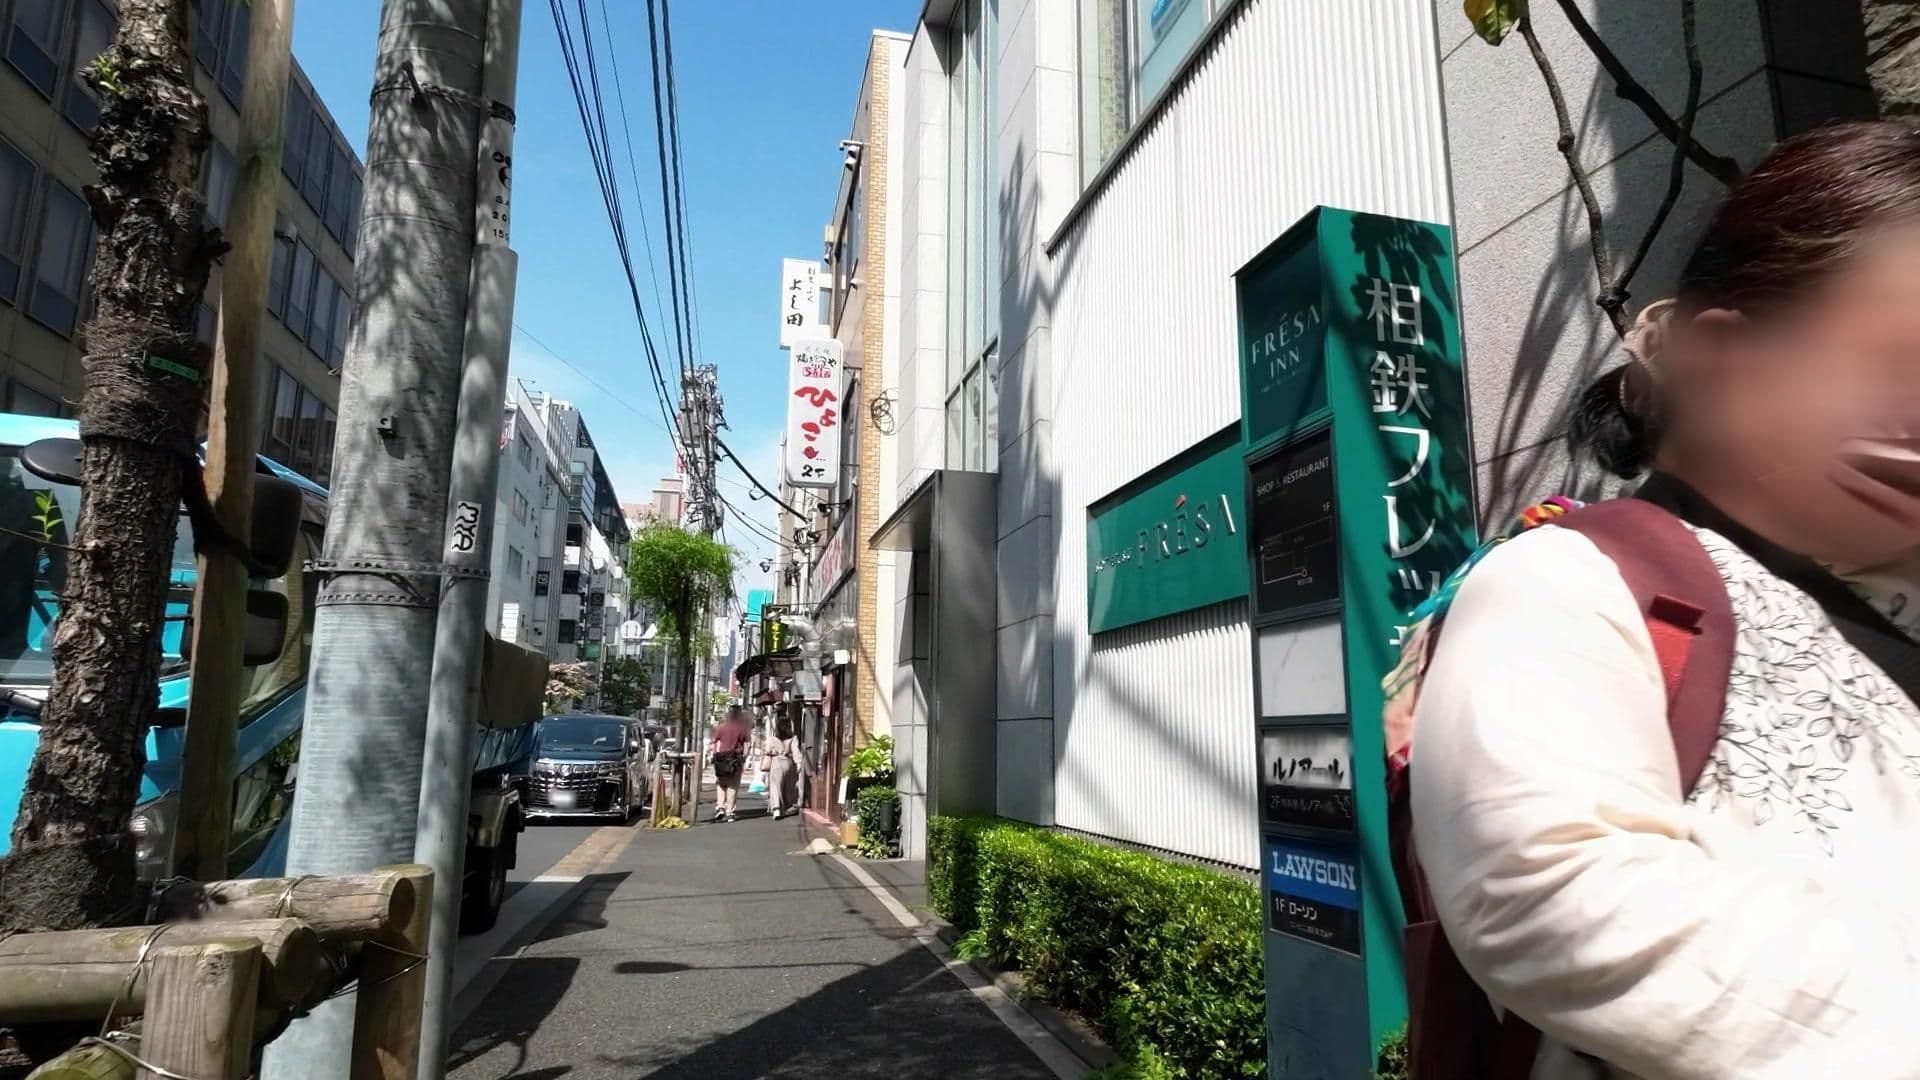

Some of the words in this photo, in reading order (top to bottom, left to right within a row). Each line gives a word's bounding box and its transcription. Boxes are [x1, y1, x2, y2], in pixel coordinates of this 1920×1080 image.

[786, 278, 804, 327] よし田
[1269, 346, 1300, 378] INN
[1256, 480, 1275, 497] SHOP
[1283, 456, 1330, 486] RESTAURANT
[1365, 277, 1441, 648] 相鉄フレッ
[1272, 756, 1345, 786] ルノアール
[1272, 850, 1357, 891] LAWSON
[1275, 896, 1286, 914] 1F
[1288, 901, 1318, 921] ローソン
